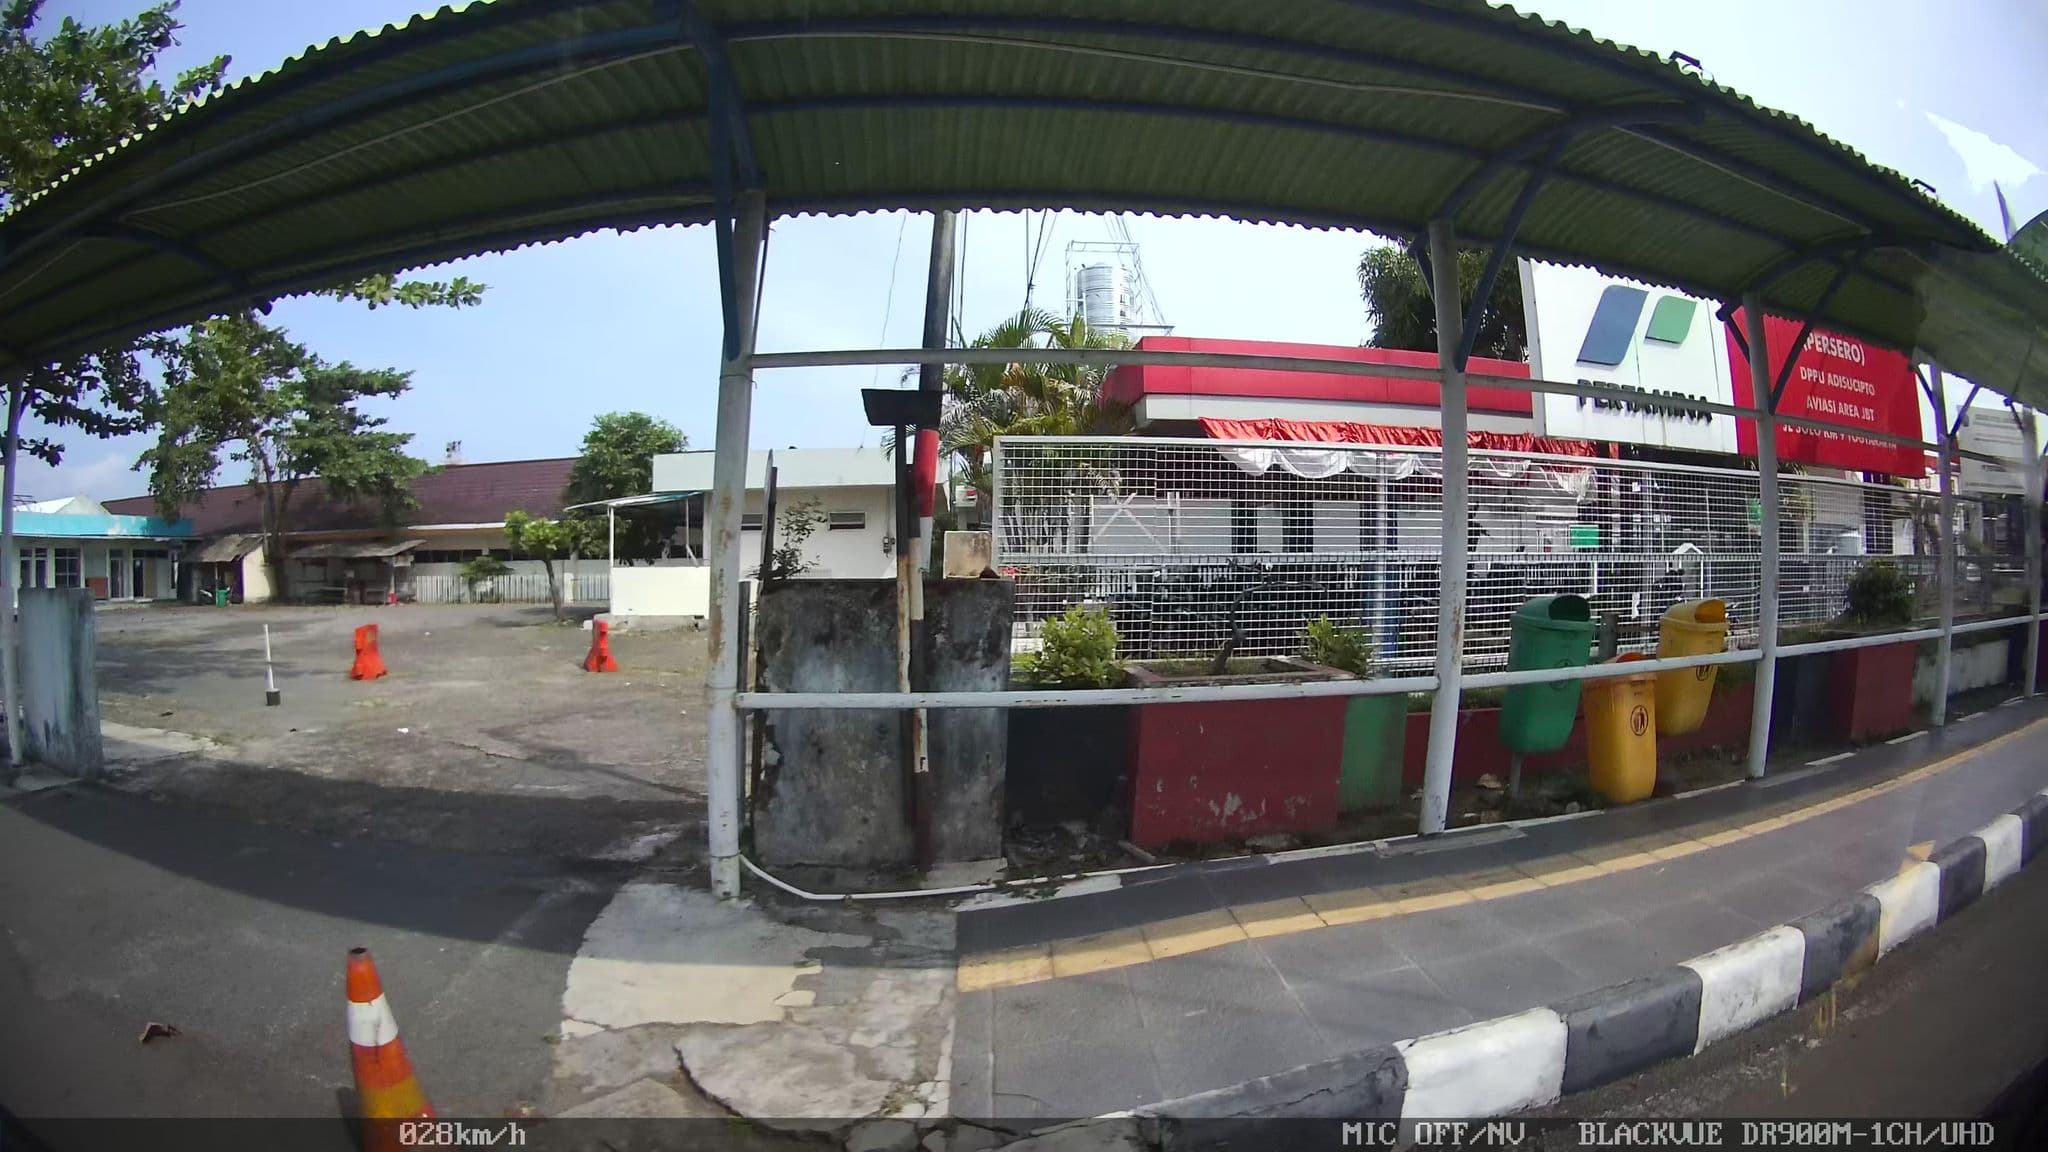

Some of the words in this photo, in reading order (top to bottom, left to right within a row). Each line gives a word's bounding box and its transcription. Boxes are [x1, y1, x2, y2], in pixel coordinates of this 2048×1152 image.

[1800, 366, 1825, 384] DPPU
[1827, 372, 1875, 397] ADISUCIPTO
[1806, 395, 1836, 413] AVIASI
[1838, 402, 1860, 418] AREA
